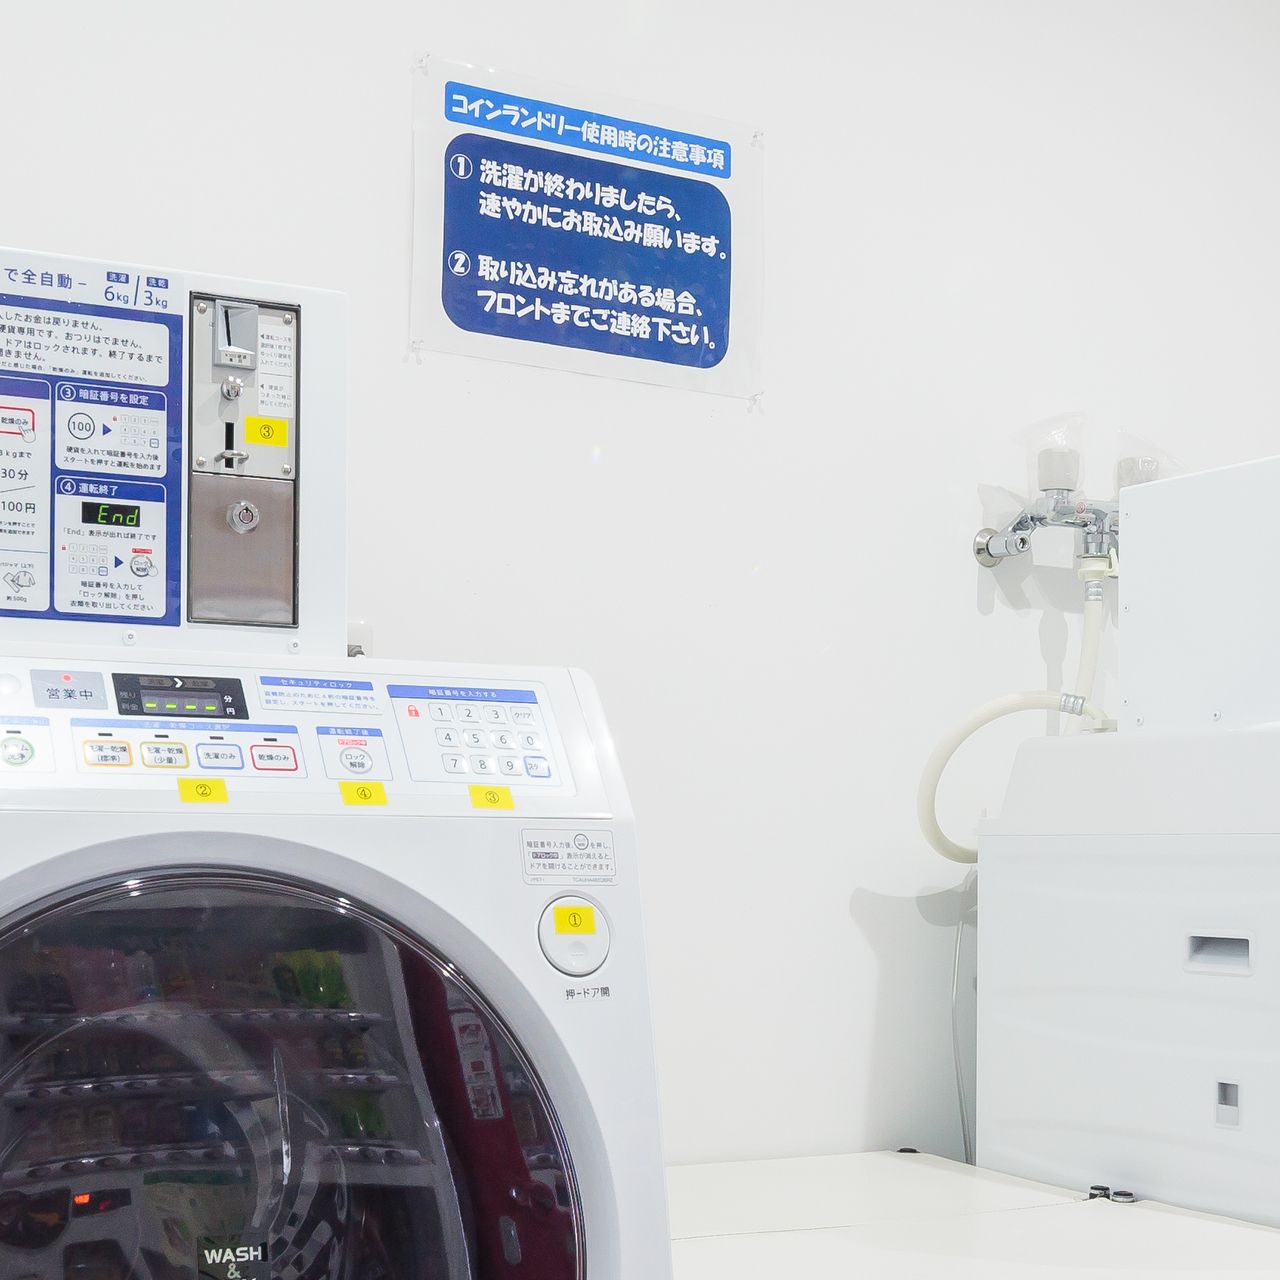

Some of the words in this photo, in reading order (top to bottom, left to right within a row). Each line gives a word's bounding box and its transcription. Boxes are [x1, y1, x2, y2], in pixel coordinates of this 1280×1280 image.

[452, 94, 724, 170] コインランドリー使用時の注意事項
[480, 158, 681, 221] 洗濯が終わりましたら、
[479, 191, 727, 259] 速やかにお取込み願います。
[478, 255, 703, 316] 取り込み忘れがある場合、
[105, 286, 129, 303] 6kg
[144, 291, 167, 308] 3kg
[477, 291, 716, 349] フロントまでご連絡下さい。
[79, 389, 148, 405] 暗証番号を設定
[1, 417, 29, 426] 乾燥のみ
[72, 422, 91, 432] 100
[1, 469, 29, 481] 30分
[79, 483, 118, 495] 運転終了
[1, 502, 36, 514] 100円
[98, 505, 138, 525] End
[81, 581, 142, 591] 暗証番号を入力して
[71, 601, 154, 611] 衣類を取り出してください
[46, 688, 92, 700] 営業中
[429, 689, 497, 698] 暗証番号を入力する
[438, 708, 443, 716] 1
[465, 709, 472, 717] 2
[493, 710, 499, 719] 3
[445, 733, 452, 742] 4
[472, 734, 479, 743] 5
[500, 735, 507, 744] 6
[527, 736, 533, 745] 0
[451, 759, 457, 768] 7
[479, 760, 486, 769] 8
[506, 761, 513, 770] 9
[204, 1246, 262, 1264] WASH
[227, 1263, 241, 1278] &
